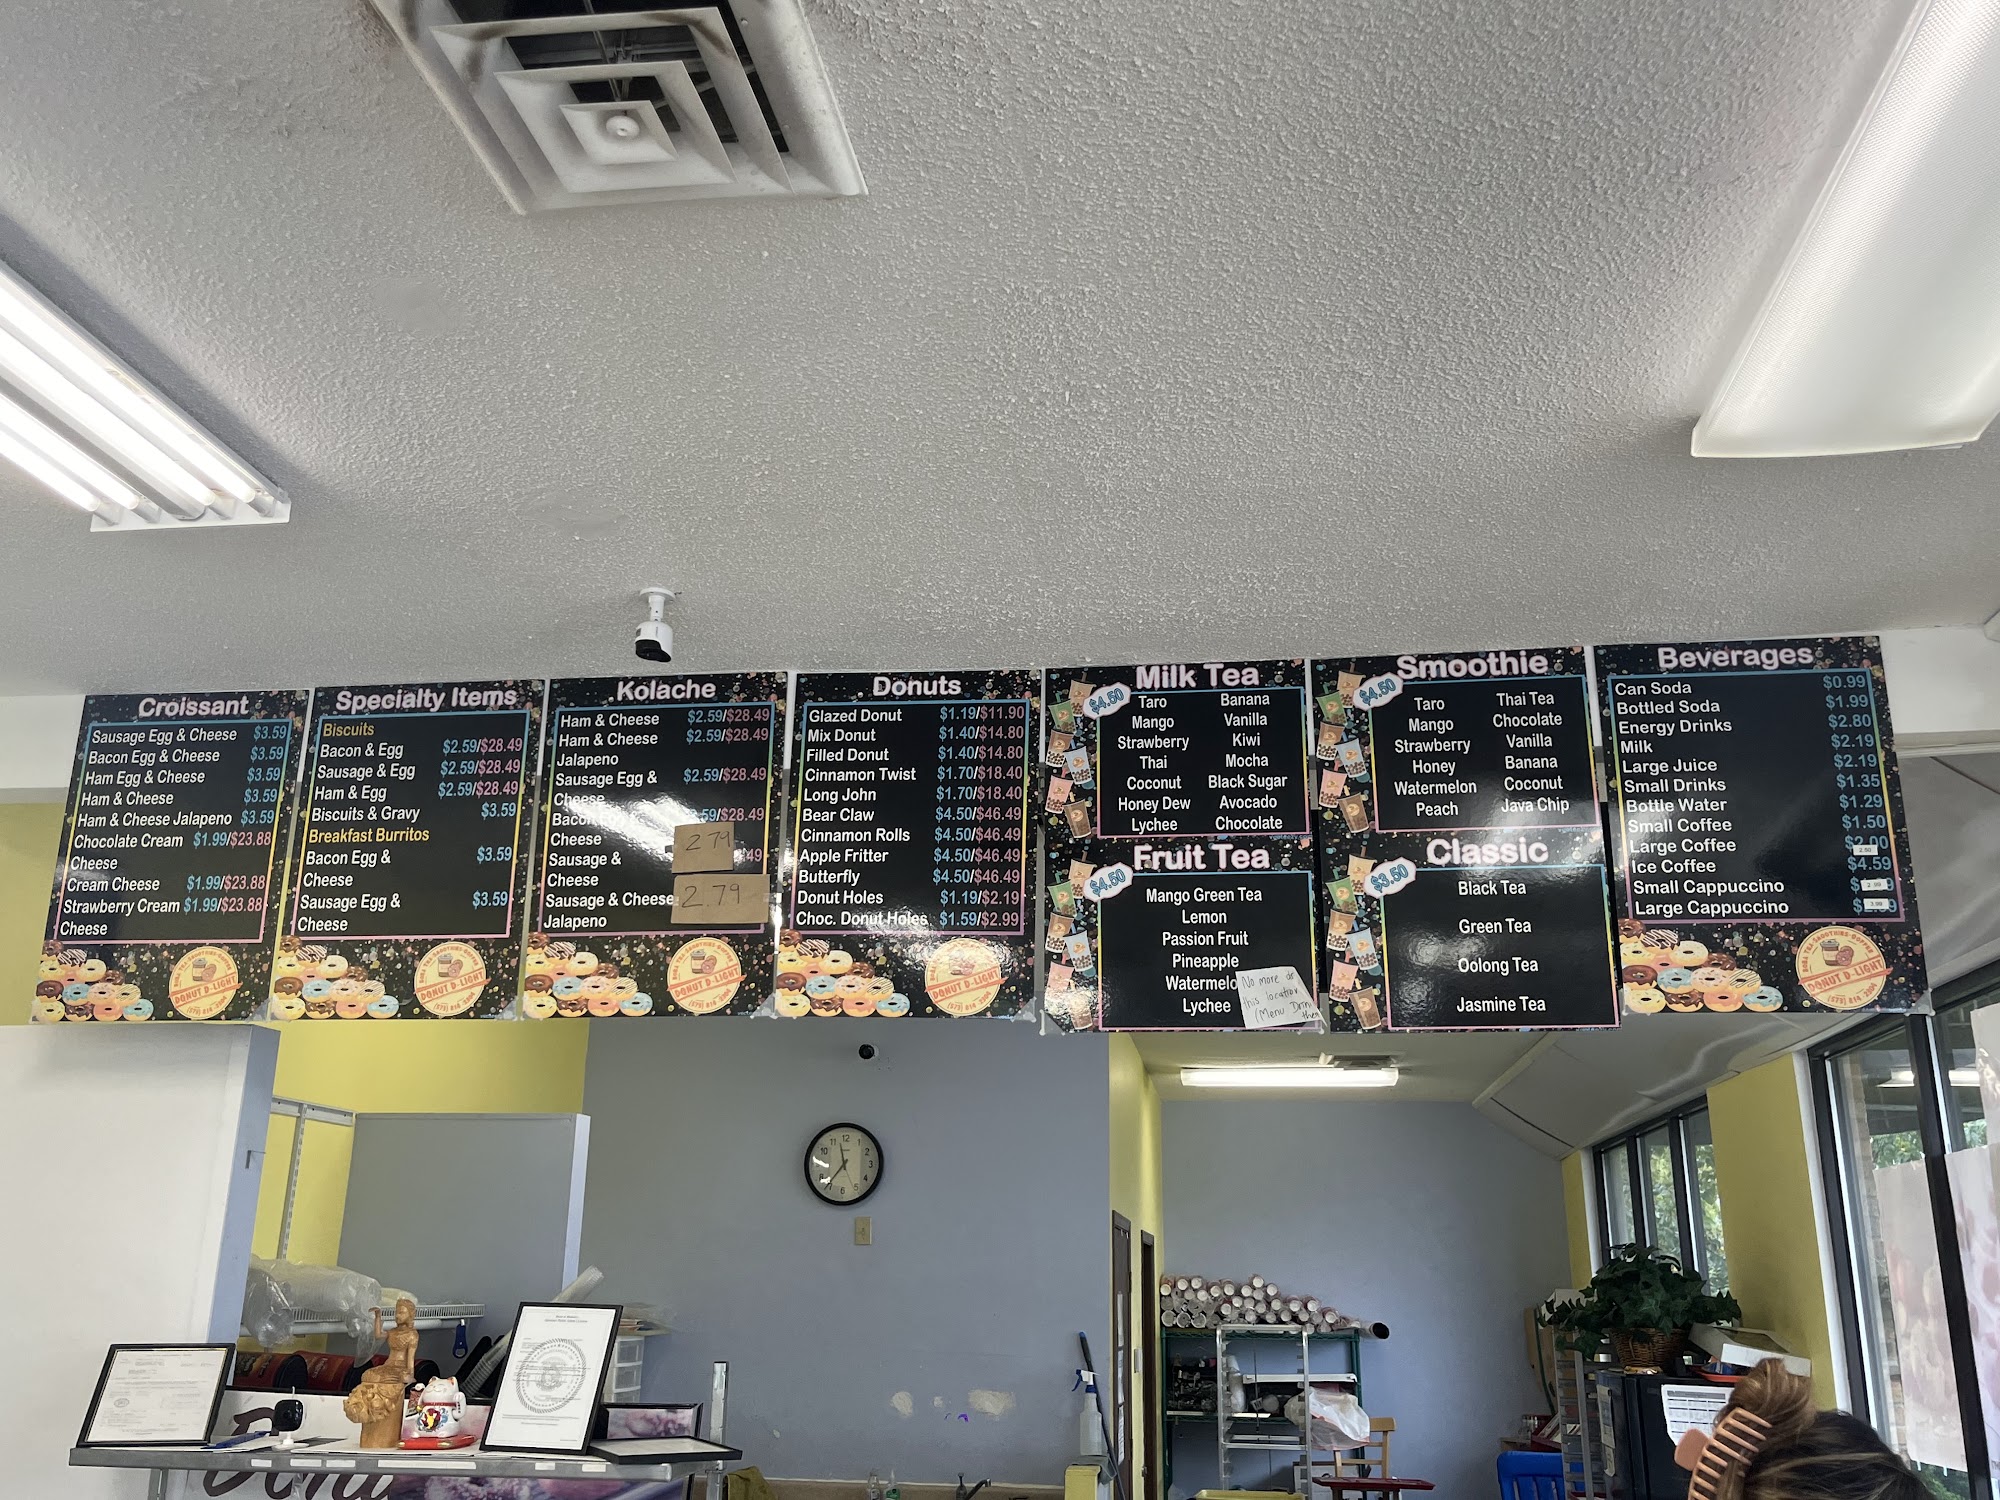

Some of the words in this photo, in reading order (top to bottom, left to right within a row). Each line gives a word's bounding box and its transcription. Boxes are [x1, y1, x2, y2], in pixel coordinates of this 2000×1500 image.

[1397, 651, 1549, 680] Smoothie
[1658, 646, 1813, 671] Beverages
[1136, 665, 1197, 690] Milk
[1202, 662, 1259, 688] Tea
[1615, 683, 1646, 695] Can
[1651, 681, 1691, 694] Soda
[1823, 675, 1865, 691] $0.99
[617, 679, 716, 701] Kolache
[873, 676, 961, 696] Donuts
[1359, 678, 1396, 705] $4.50
[139, 695, 249, 718] Croissant
[336, 689, 445, 712] Specialty
[452, 689, 518, 707] Items
[1089, 688, 1124, 714] $4.50
[1138, 696, 1167, 708] Taro
[1221, 693, 1270, 706] Banana
[1496, 693, 1526, 706] Thai
[1529, 692, 1554, 705] Tea
[561, 715, 591, 727] Ham
[595, 714, 605, 726] &
[609, 713, 659, 726] Cheese
[688, 709, 769, 725] $2.59/$28.49
[809, 709, 857, 722] Glazed
[861, 709, 902, 721] Donut
[940, 705, 1024, 722] $1.19/$11.90
[1224, 712, 1267, 726] Vanilla
[323, 722, 374, 736] Biscuits
[1132, 716, 1174, 731] Mango
[1619, 721, 1675, 736] Energy
[1680, 719, 1732, 732] Drinks
[1828, 714, 1871, 730] $2.80
[92, 730, 145, 746] Sausage
[149, 729, 173, 745] Egg
[177, 728, 185, 741] &
[190, 728, 237, 741] Cheese
[254, 725, 286, 741] $3.59
[808, 729, 831, 742] Mix
[835, 729, 876, 741] Donut
[939, 725, 1023, 742] $1.40/$14.80
[1233, 733, 1260, 746] Kiwi
[1118, 735, 1189, 751] Strawberry
[1621, 740, 1653, 753] Milk
[1831, 733, 1874, 750] $2.19
[557, 753, 618, 769] Jalapeno
[1140, 755, 1167, 769] Thai
[1226, 753, 1268, 767] Mocha
[1413, 760, 1455, 776] Honey
[1623, 760, 1668, 775] Large
[1673, 759, 1717, 772] Juice
[1834, 753, 1877, 770] $2.19
[317, 765, 373, 781] Sausage
[377, 765, 386, 778] &
[390, 763, 415, 780] Egg
[441, 759, 520, 777] $2.59/$28.49
[556, 773, 613, 788] Sausage
[617, 772, 643, 787] Egg
[647, 771, 657, 783] &
[684, 767, 766, 784] $2.59/$28.49
[805, 768, 874, 781] Cinnamon
[879, 767, 916, 780] Twist
[937, 765, 1022, 782] $1.70/$18.40
[1209, 774, 1244, 788] Black
[1248, 774, 1287, 790] Sugar
[1394, 780, 1477, 795] Watermelon
[1625, 779, 1668, 793] Small
[1674, 778, 1726, 791] Drinks
[1837, 773, 1880, 790] $1.35
[315, 786, 344, 800] Ham
[348, 785, 357, 799] &
[361, 785, 387, 802] Egg
[438, 781, 518, 799] $2.59/$28.49
[804, 788, 838, 804] Long
[842, 788, 876, 801] John
[937, 785, 1022, 802] $1.70/$18.40
[1119, 797, 1159, 813] Honey
[1163, 796, 1190, 809] Dew
[1220, 794, 1277, 809] Avocado
[1416, 801, 1458, 816] Peach
[1501, 798, 1534, 813] Java
[1538, 797, 1569, 815] Chip
[78, 813, 106, 827] Ham
[110, 813, 118, 826] &
[123, 812, 170, 826] Cheese
[173, 811, 232, 828] Jalapeno
[241, 810, 274, 827] $3.59
[311, 807, 364, 822] Biscuits
[368, 806, 378, 820] &
[381, 806, 420, 823] Gravy
[481, 802, 516, 820] $3.59
[75, 834, 137, 848] Chocolate
[141, 833, 183, 847] Cream
[194, 831, 271, 848] $1.99/$23.88
[309, 828, 373, 843] Breakfast
[376, 827, 429, 841] Burritos
[549, 853, 607, 869] Sausage
[611, 851, 621, 865] &
[1132, 844, 1206, 872] Fruit
[1214, 843, 1270, 870] Tea
[1427, 839, 1548, 864] Classic
[1632, 858, 1656, 873] Ice
[1661, 859, 1716, 873] Coffee
[1848, 856, 1891, 873] $4.59
[547, 873, 598, 887] Cheese
[799, 869, 860, 886] Butterfly
[933, 868, 1020, 885] $4.50/$46.49
[1089, 868, 1126, 897] $4.50
[1370, 863, 1409, 892] $3.50
[1147, 889, 1190, 905] Mango
[1194, 888, 1234, 902] Green
[1237, 887, 1262, 901] Tea
[1458, 880, 1497, 895] Black
[1500, 880, 1526, 894] Tea
[1634, 880, 1678, 894] Small
[1684, 879, 1784, 896] Cappuccino
[64, 899, 135, 916] Strawberry
[138, 898, 180, 912] Cream
[184, 897, 262, 914] $1.99/$23.88
[544, 914, 607, 931] Jalapeno
[1182, 910, 1226, 923] Lemon
[1163, 931, 1214, 946] Passion
[1218, 931, 1249, 945] Fruit
[1173, 953, 1239, 971] Pineapple
[1458, 958, 1509, 976] Oolong
[1512, 957, 1538, 972] Tea
[675, 983, 703, 997] DONUT
[705, 968, 739, 986] D-LIGHT
[1242, 976, 1254, 989] No
[1260, 975, 1279, 985] more
[1808, 975, 1841, 992] DONUT
[1843, 959, 1883, 980] D-LIGHT
[1457, 997, 1516, 1012] Jasmine
[1519, 996, 1546, 1011] Tea
[842, 1134, 849, 1142] 12
